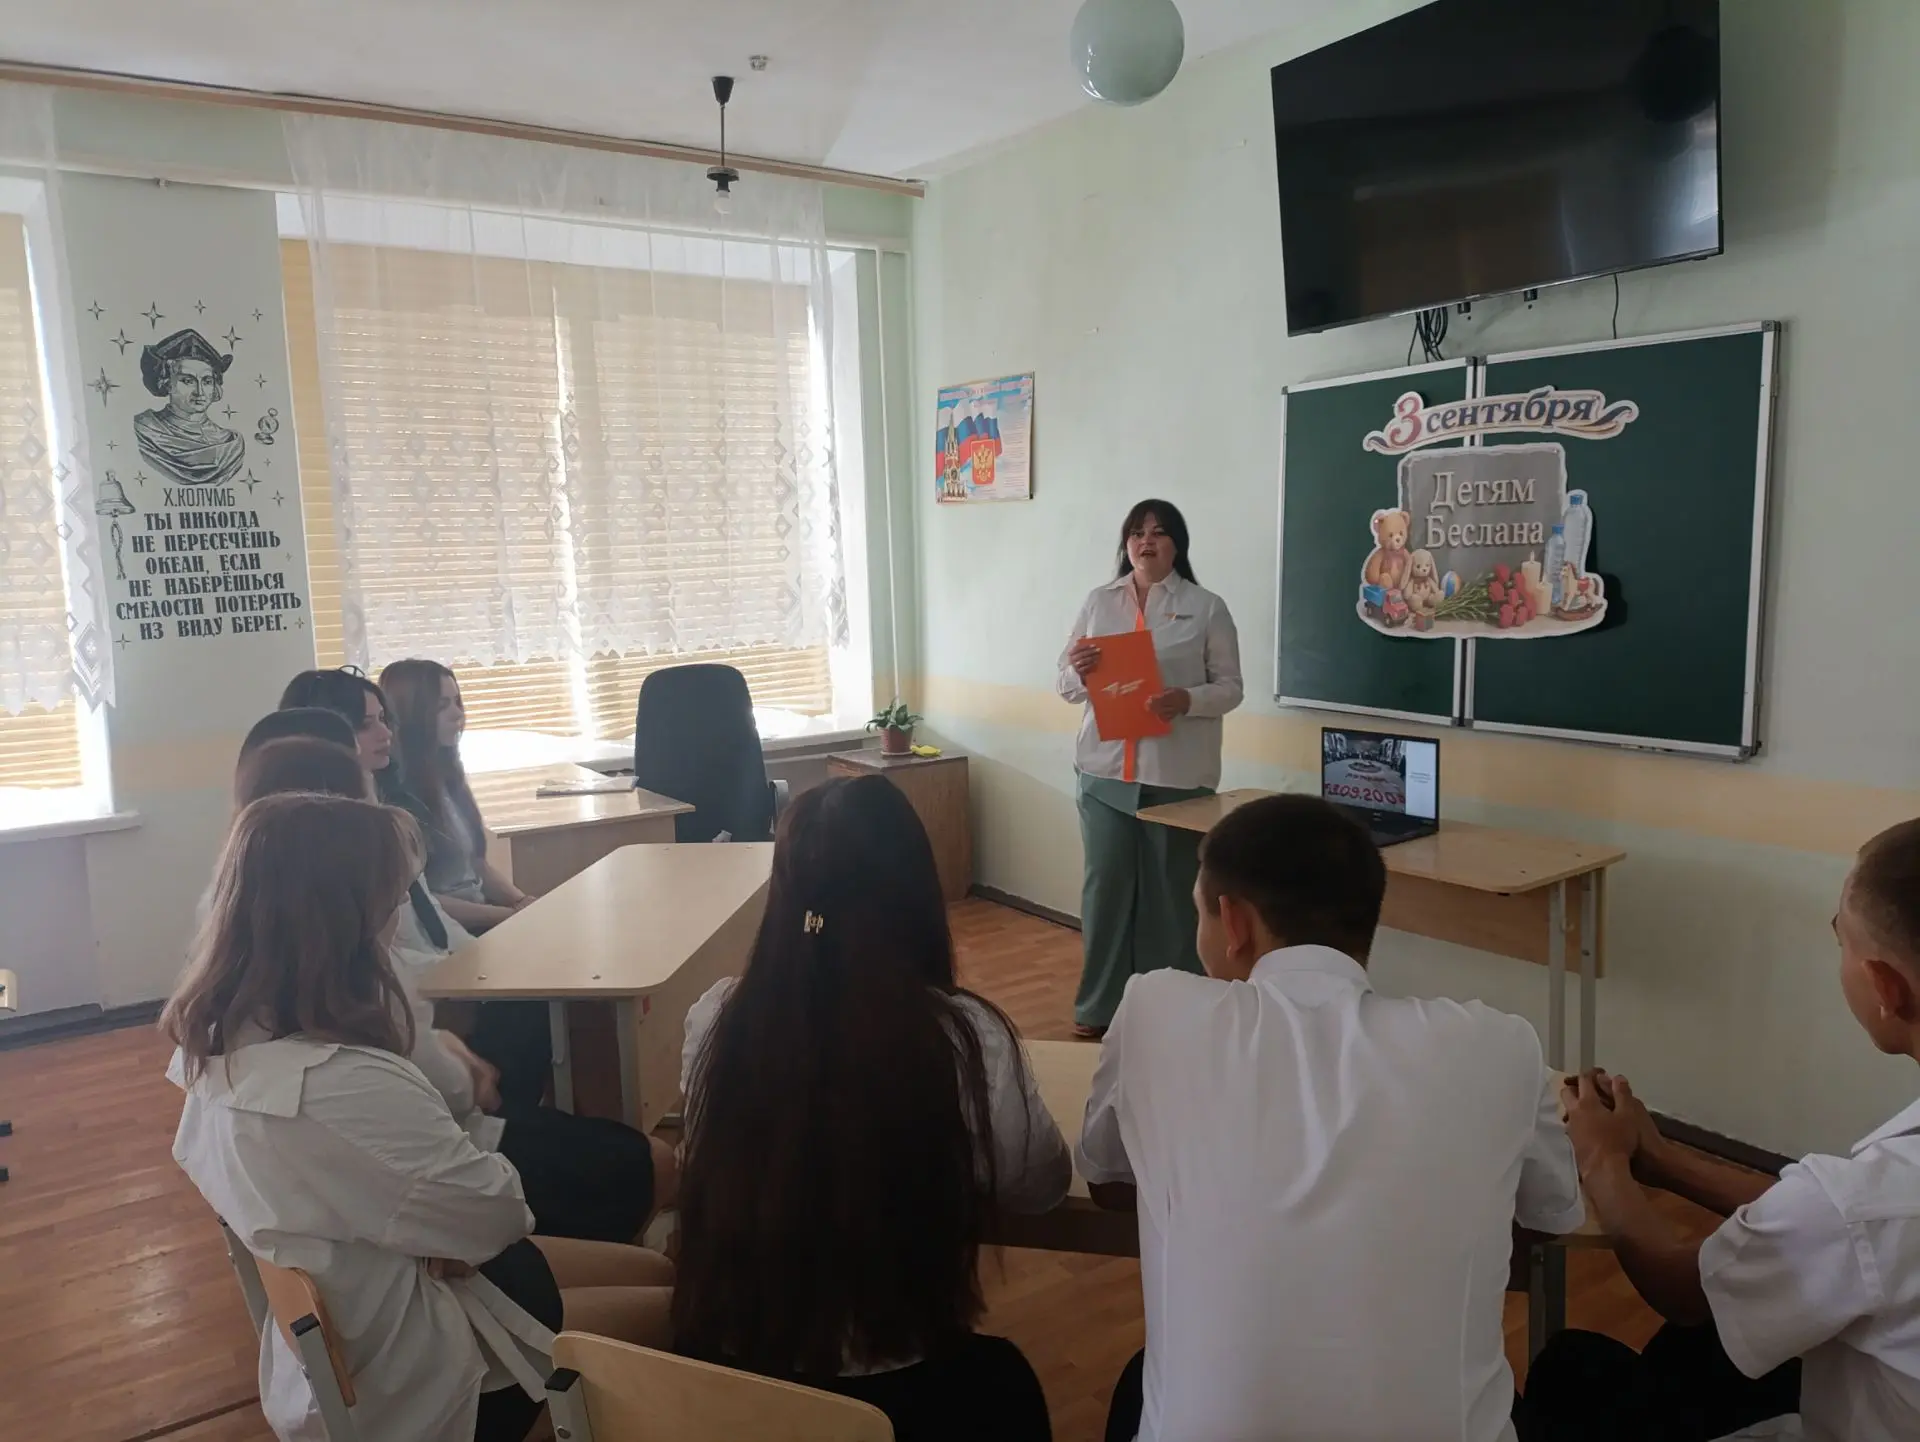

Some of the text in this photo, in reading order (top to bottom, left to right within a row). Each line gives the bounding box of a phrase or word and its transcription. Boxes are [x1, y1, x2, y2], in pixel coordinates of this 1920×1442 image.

[1388, 390, 1595, 446] 3 сентября
[163, 488, 236, 507] Х.КОЛУМБ
[1429, 471, 1536, 513] Детям
[144, 511, 260, 531] ТЫ НИКОГДА
[1424, 515, 1545, 549] Беслана
[132, 528, 281, 553] НЕ ПЕРЕСЕЧЁШЬ
[146, 553, 261, 575] ОКЕАН, ЕСЛИ
[129, 572, 284, 597] НЕ НАБЕРЁШЬСЯ
[116, 592, 301, 620] СМЕЛОСТИ ПОТЕРЯТЬ
[140, 614, 287, 640] ИЗ ВИДУ БЕРЕГ.
